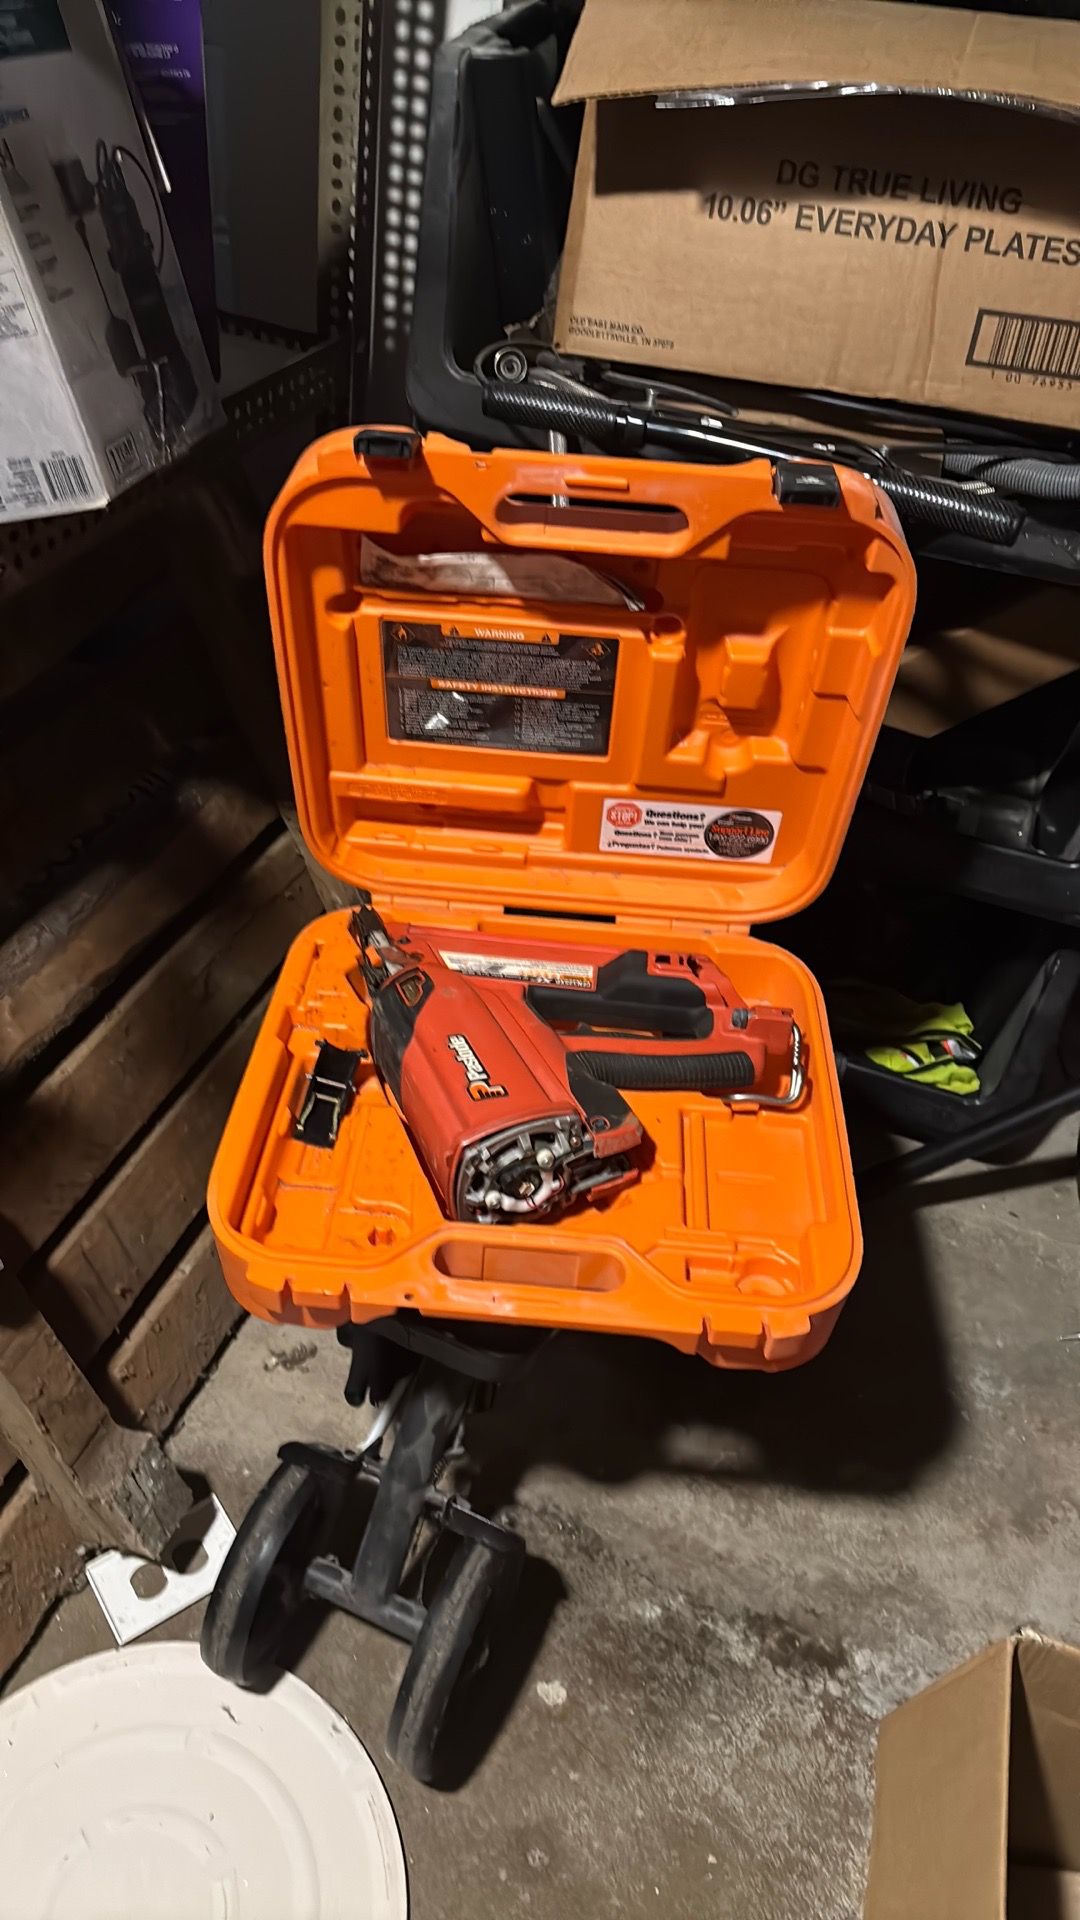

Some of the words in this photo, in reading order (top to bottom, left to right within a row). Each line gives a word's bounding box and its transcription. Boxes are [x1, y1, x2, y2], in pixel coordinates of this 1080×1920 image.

[776, 159, 820, 188] DG
[832, 164, 912, 201] TRUE
[919, 176, 1024, 215] LIVING
[794, 203, 959, 250] EVERYDAY
[963, 225, 1080, 267] PLATES
[609, 319, 630, 333] MAIN
[474, 627, 525, 641] WARNING
[437, 679, 479, 692] SAFETY
[480, 682, 559, 698] INSTRUCTIONS
[671, 821, 687, 829] help
